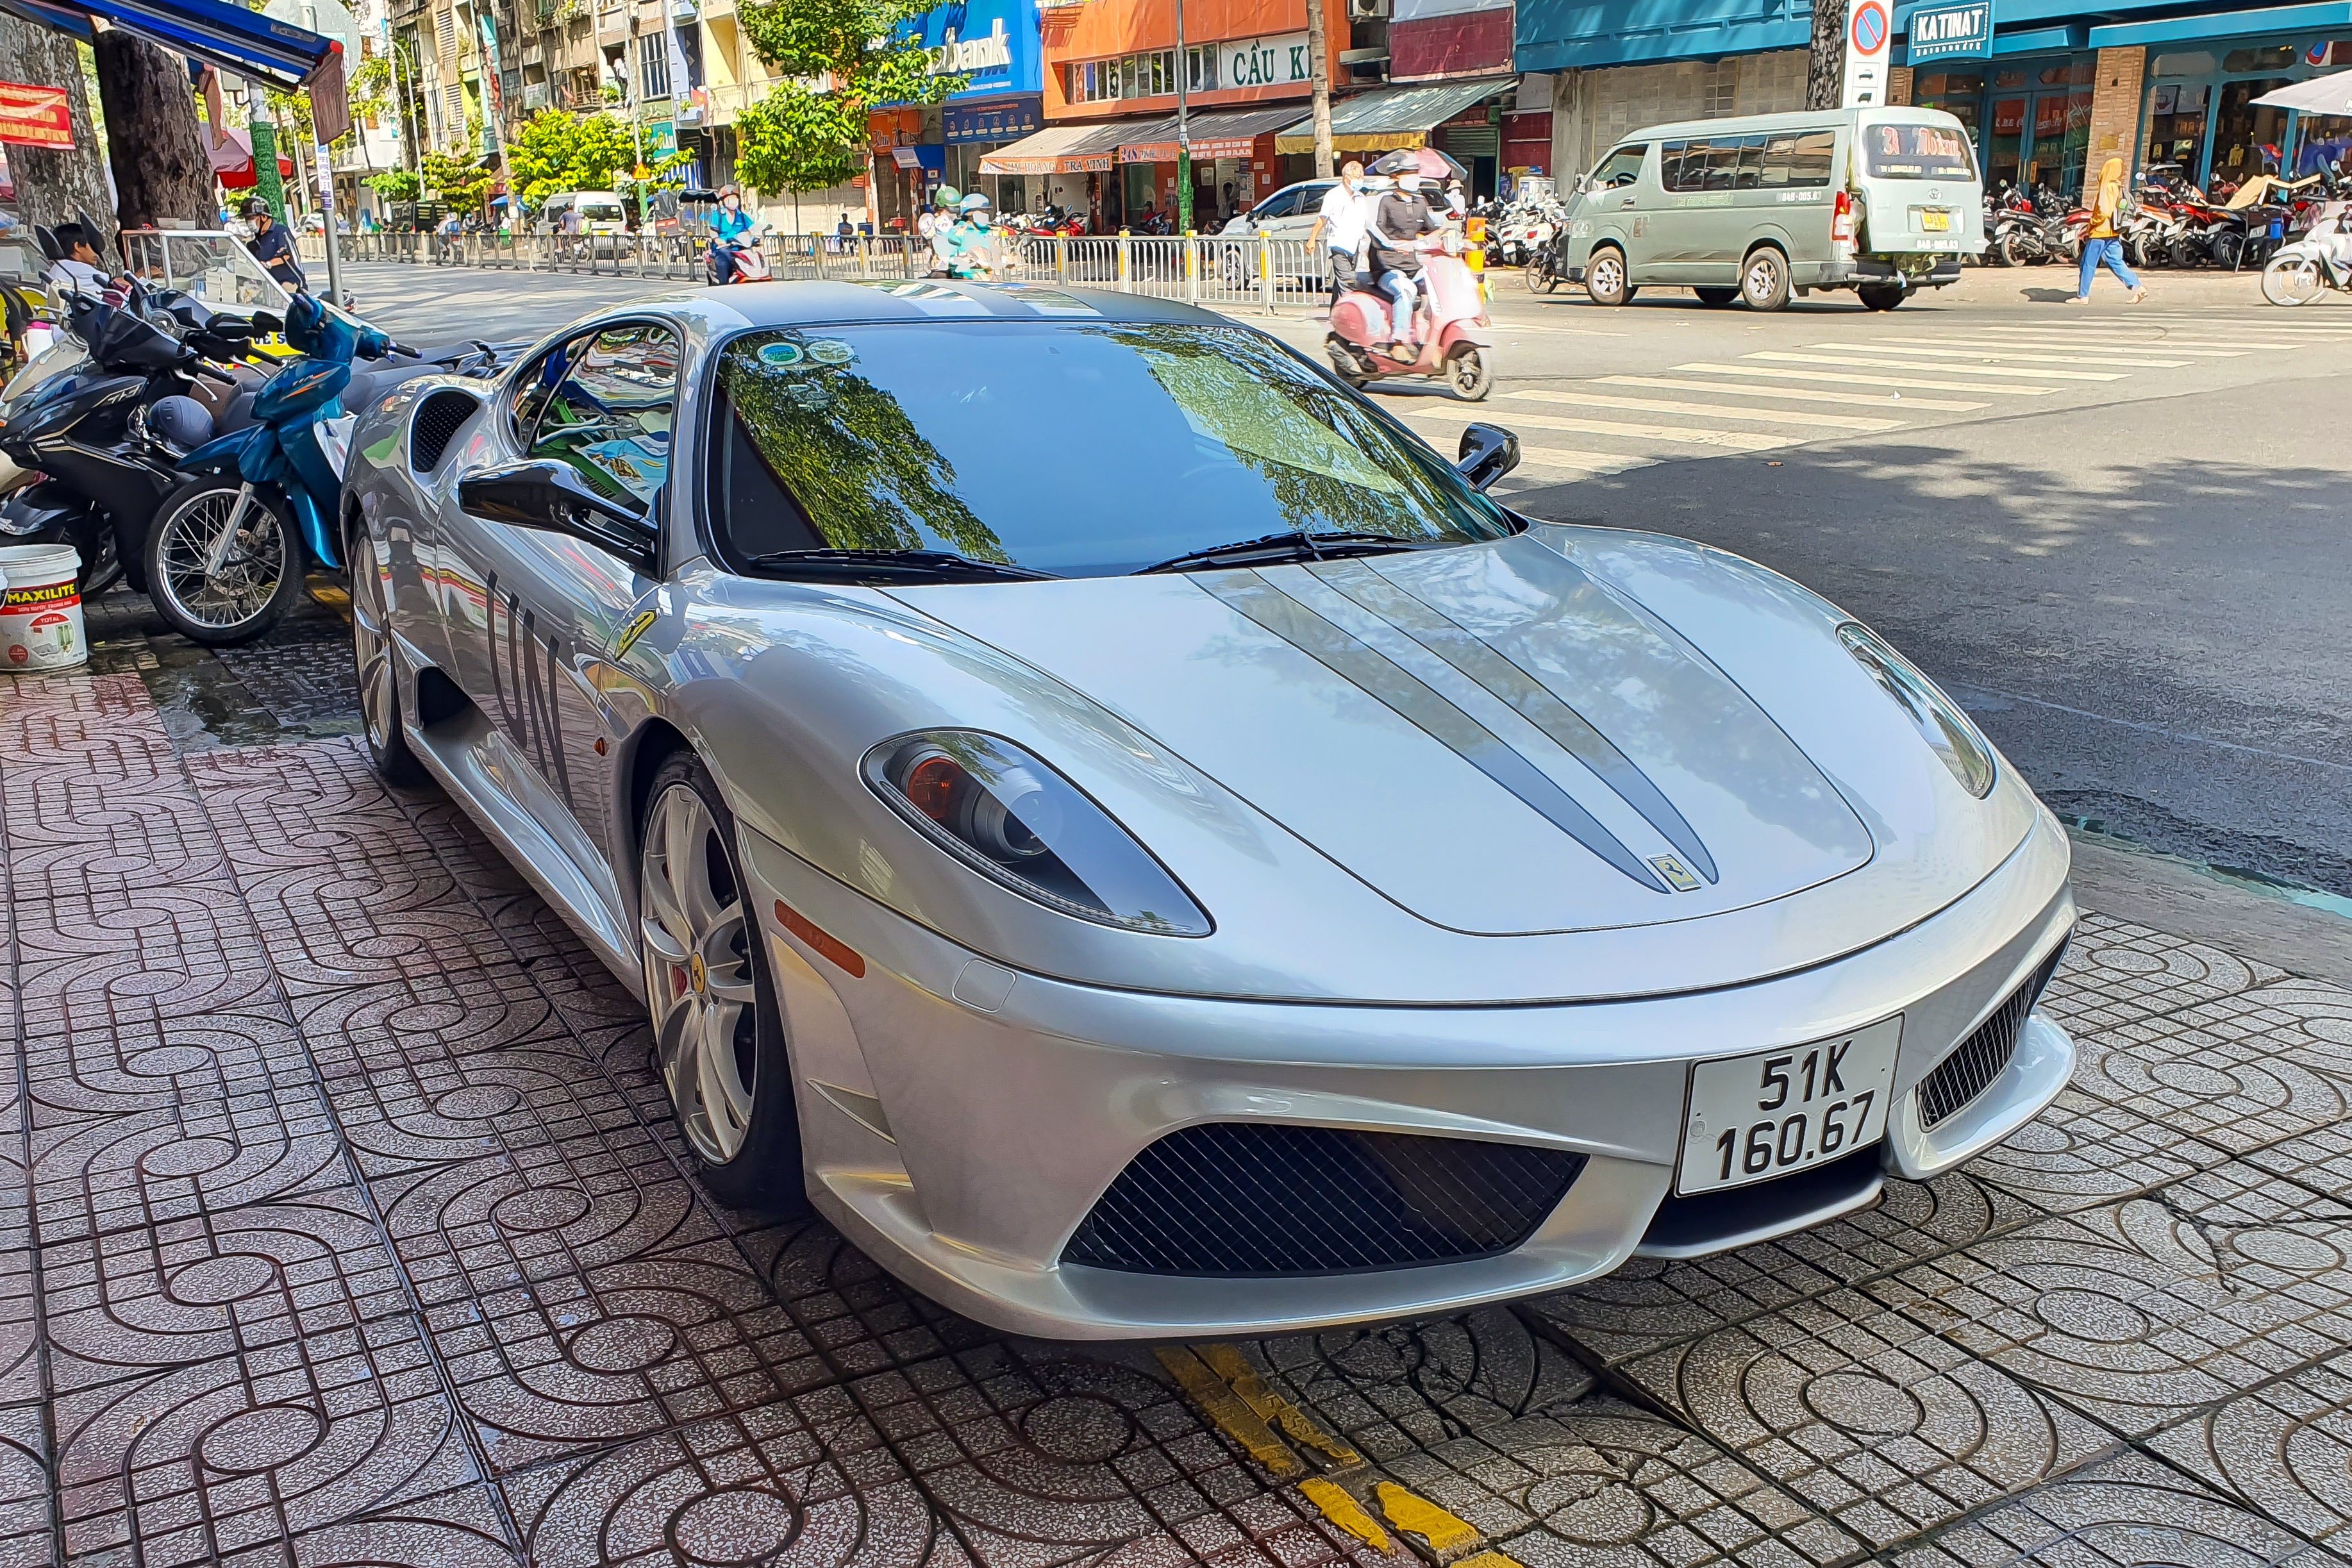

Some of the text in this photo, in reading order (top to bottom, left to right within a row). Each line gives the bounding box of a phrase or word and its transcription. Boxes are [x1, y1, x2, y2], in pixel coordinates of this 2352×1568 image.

[1917, 9, 1983, 42] KATINAT
[1233, 38, 1275, 86] CẦU
[1064, 158, 1083, 171] TRÀ
[1087, 158, 1110, 170] VINH
[7, 584, 75, 603] MAXILITE
[1758, 1038, 1853, 1111] 51K
[1716, 1088, 1876, 1181] 160.67
